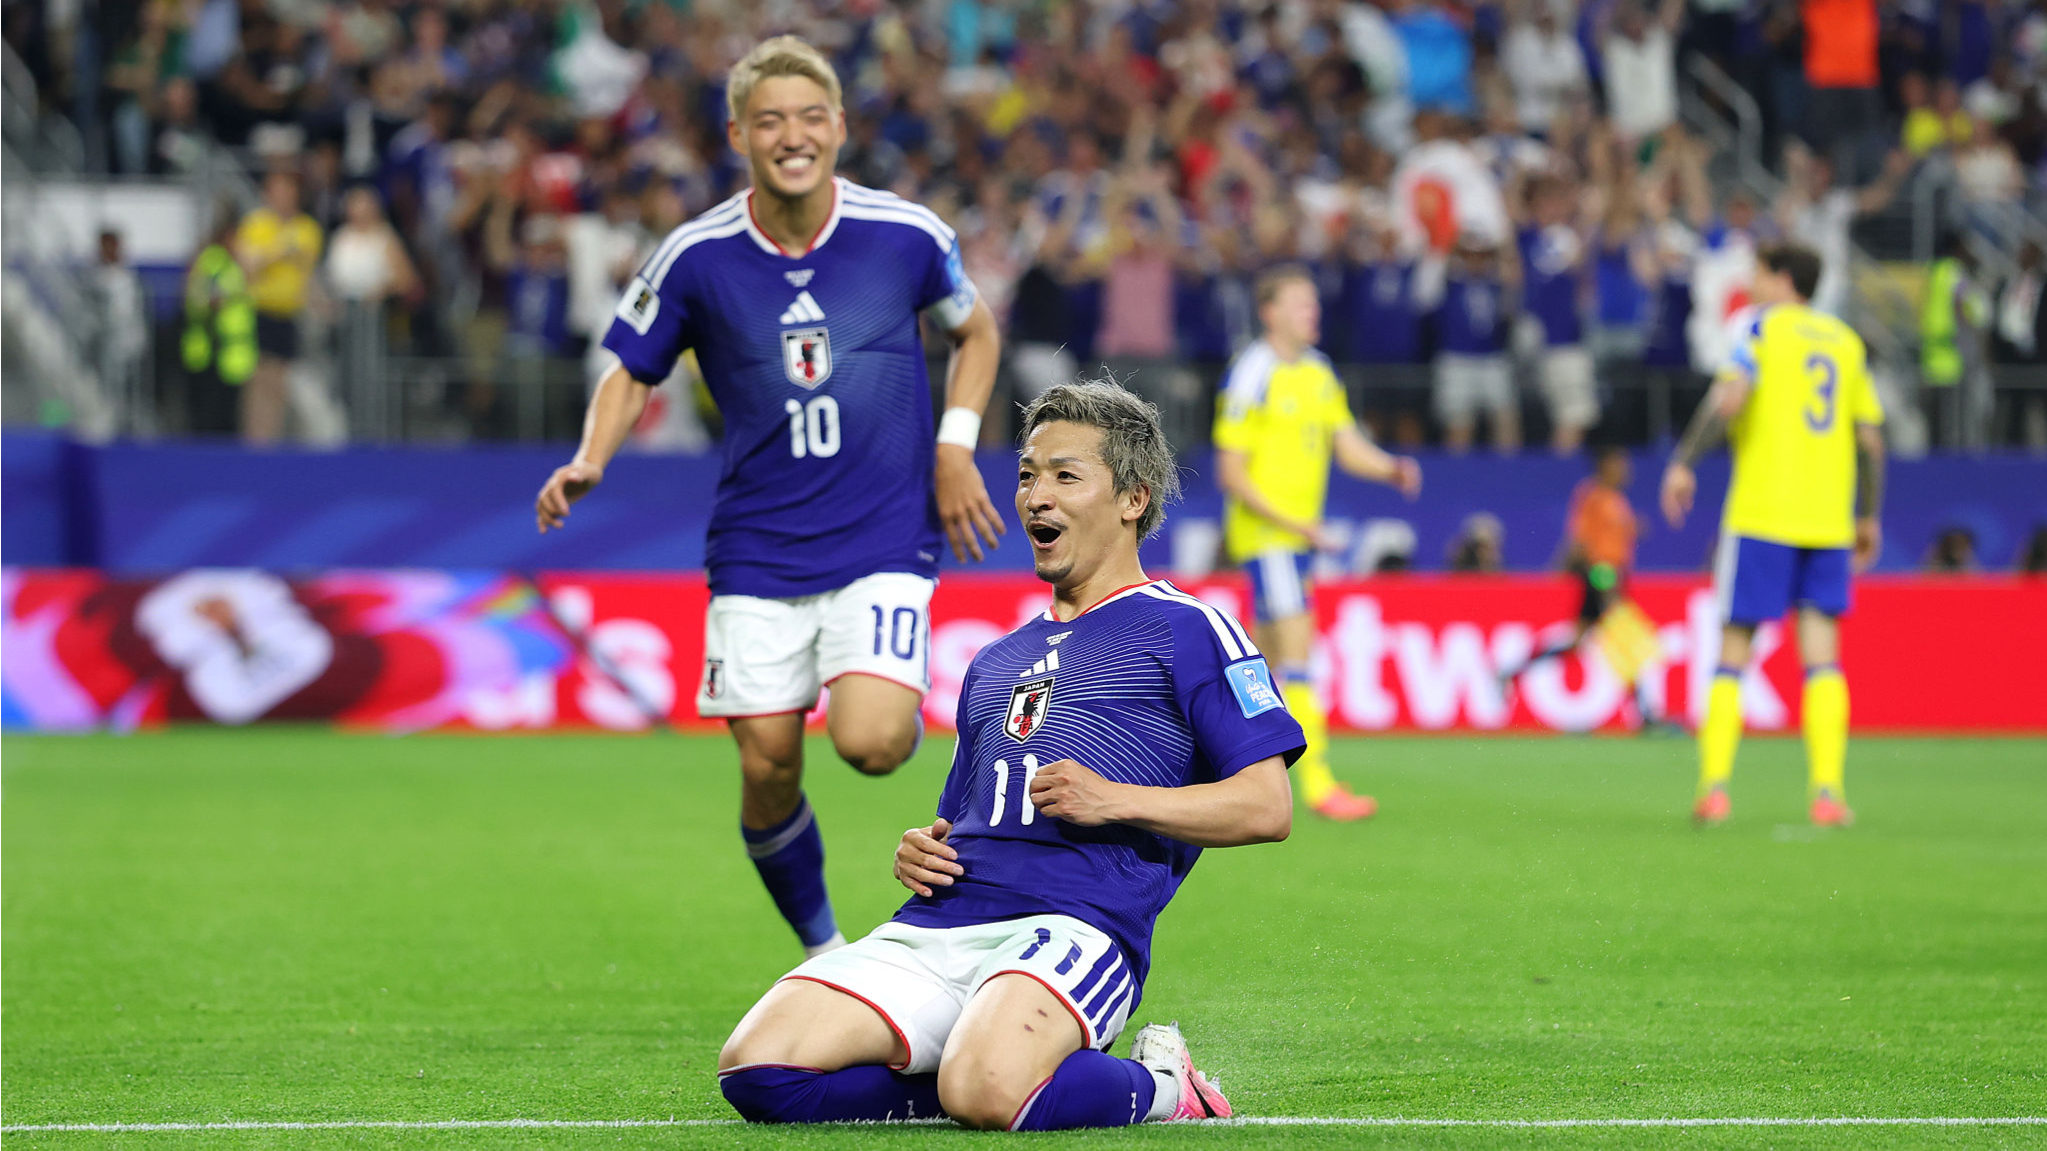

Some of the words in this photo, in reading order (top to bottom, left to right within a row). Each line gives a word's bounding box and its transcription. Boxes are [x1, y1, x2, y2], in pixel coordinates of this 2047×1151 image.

[1803, 352, 1838, 435] 3
[785, 395, 841, 458] 10
[871, 604, 918, 660] 10
[1022, 681, 1046, 692] JAPAN
[988, 753, 1039, 828] 11
